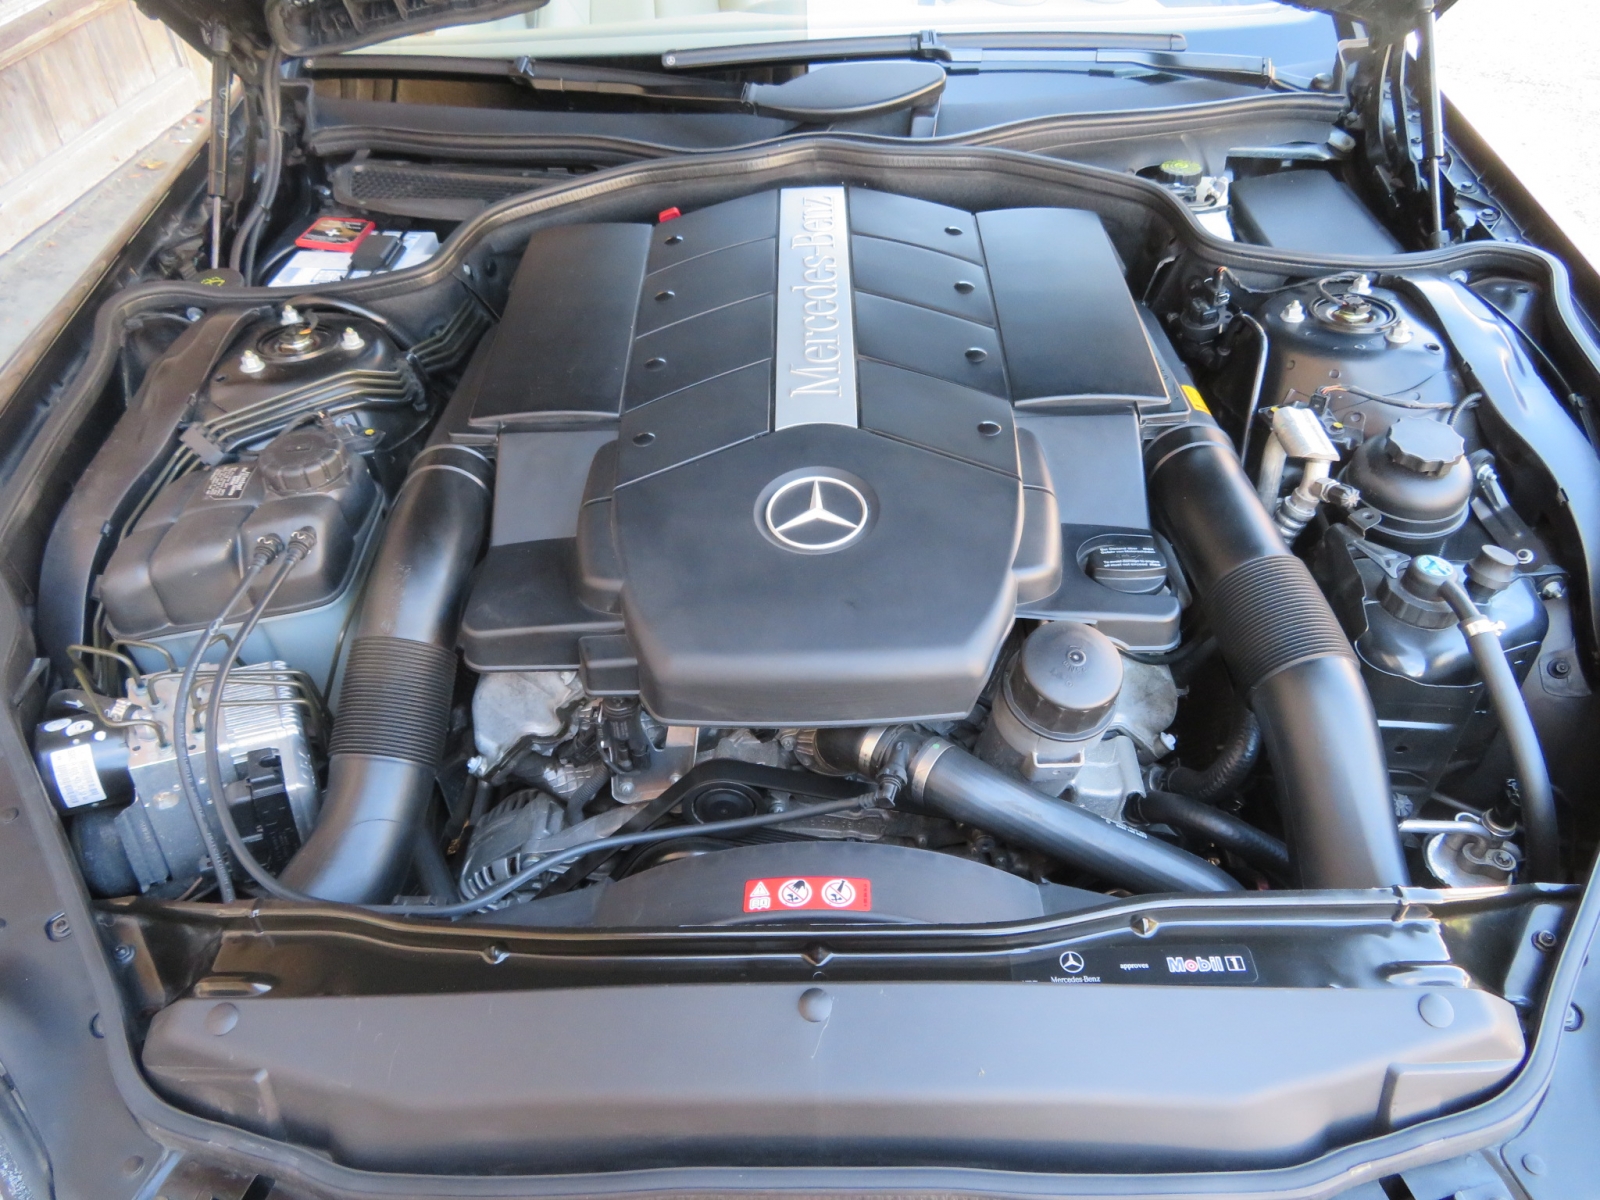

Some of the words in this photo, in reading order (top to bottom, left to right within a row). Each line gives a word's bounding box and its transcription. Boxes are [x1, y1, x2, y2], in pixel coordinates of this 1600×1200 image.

[789, 195, 843, 398] Mercedes-Benz
[1166, 956, 1225, 973] Mobil
[1050, 975, 1101, 984] Mercedes-Benz
